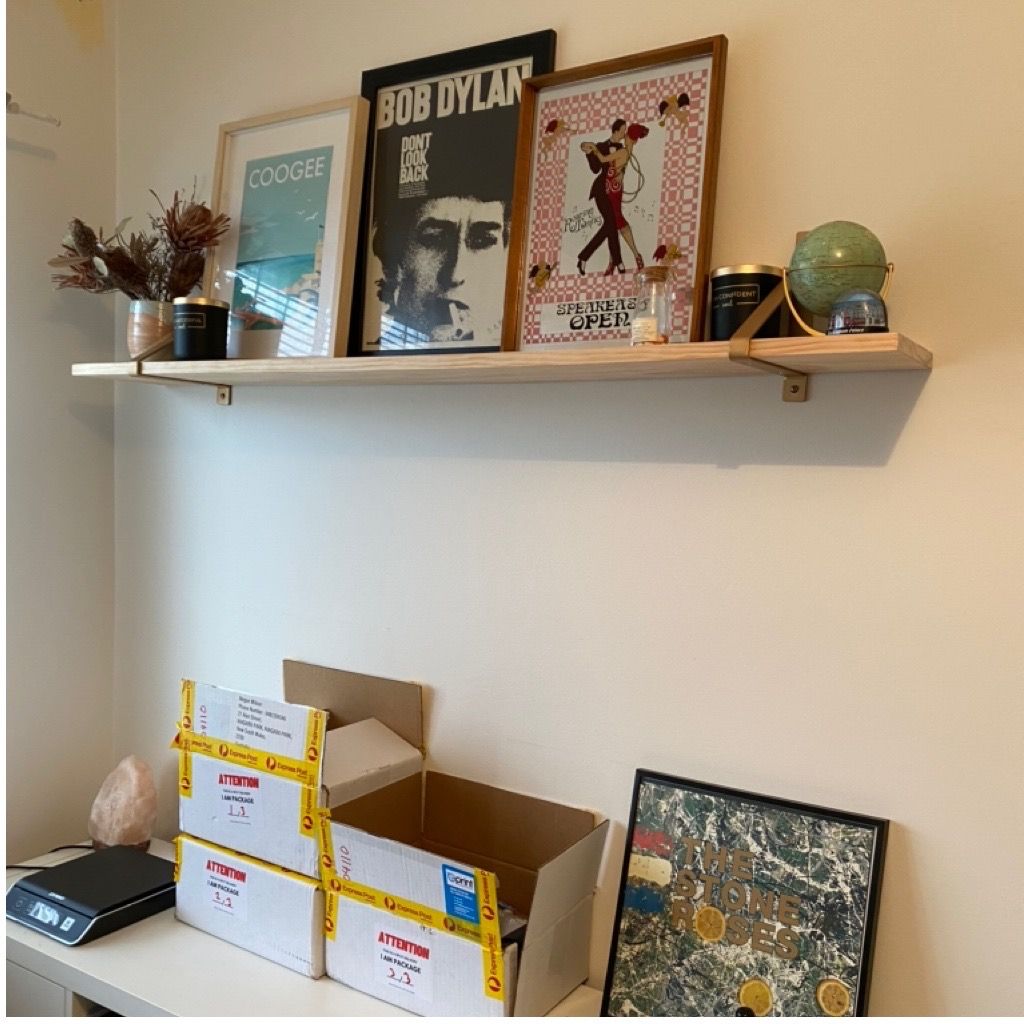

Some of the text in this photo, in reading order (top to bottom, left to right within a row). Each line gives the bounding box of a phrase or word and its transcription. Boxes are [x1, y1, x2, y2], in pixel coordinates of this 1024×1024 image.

[378, 62, 529, 130] BOB DYLAN
[401, 132, 433, 152] DONT
[400, 148, 428, 168] LOOK
[249, 156, 325, 189] COOGEE
[399, 164, 430, 184] BACK
[569, 312, 631, 330] OPEN
[229, 749, 247, 760] Express
[277, 761, 296, 773] Express
[218, 773, 260, 789] ATTENTION
[232, 796, 255, 804] PACKAGE
[680, 837, 757, 880] THE
[206, 859, 247, 883] ATTENTION
[217, 884, 239, 897] PACKAGE
[342, 885, 362, 898] Express
[482, 878, 490, 905] Express
[675, 868, 801, 927] STONE
[396, 901, 432, 920] Express Post
[456, 924, 481, 938] Express
[378, 931, 430, 960] ATTENTION
[383, 954, 393, 964] AM
[393, 957, 422, 974] PACKAGE
